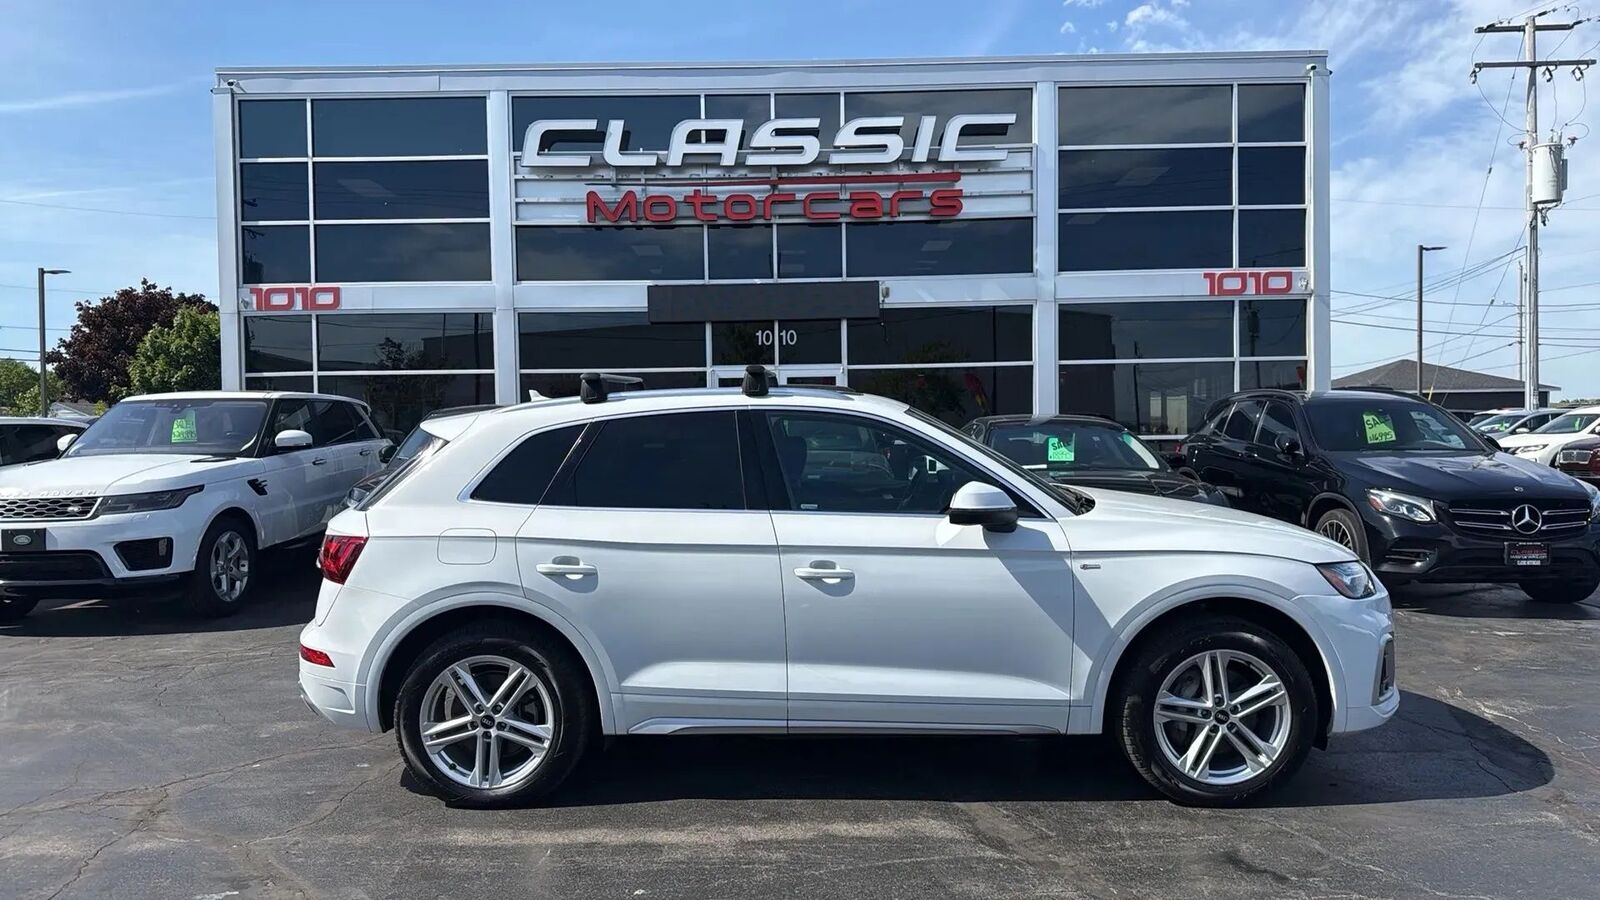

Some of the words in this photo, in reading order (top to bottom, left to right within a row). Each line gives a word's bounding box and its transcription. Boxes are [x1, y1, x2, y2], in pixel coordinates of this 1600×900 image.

[520, 113, 1017, 167] CLASSIC
[586, 189, 963, 223] Motorcars
[1203, 271, 1292, 296] 1010
[249, 287, 341, 311] 1010
